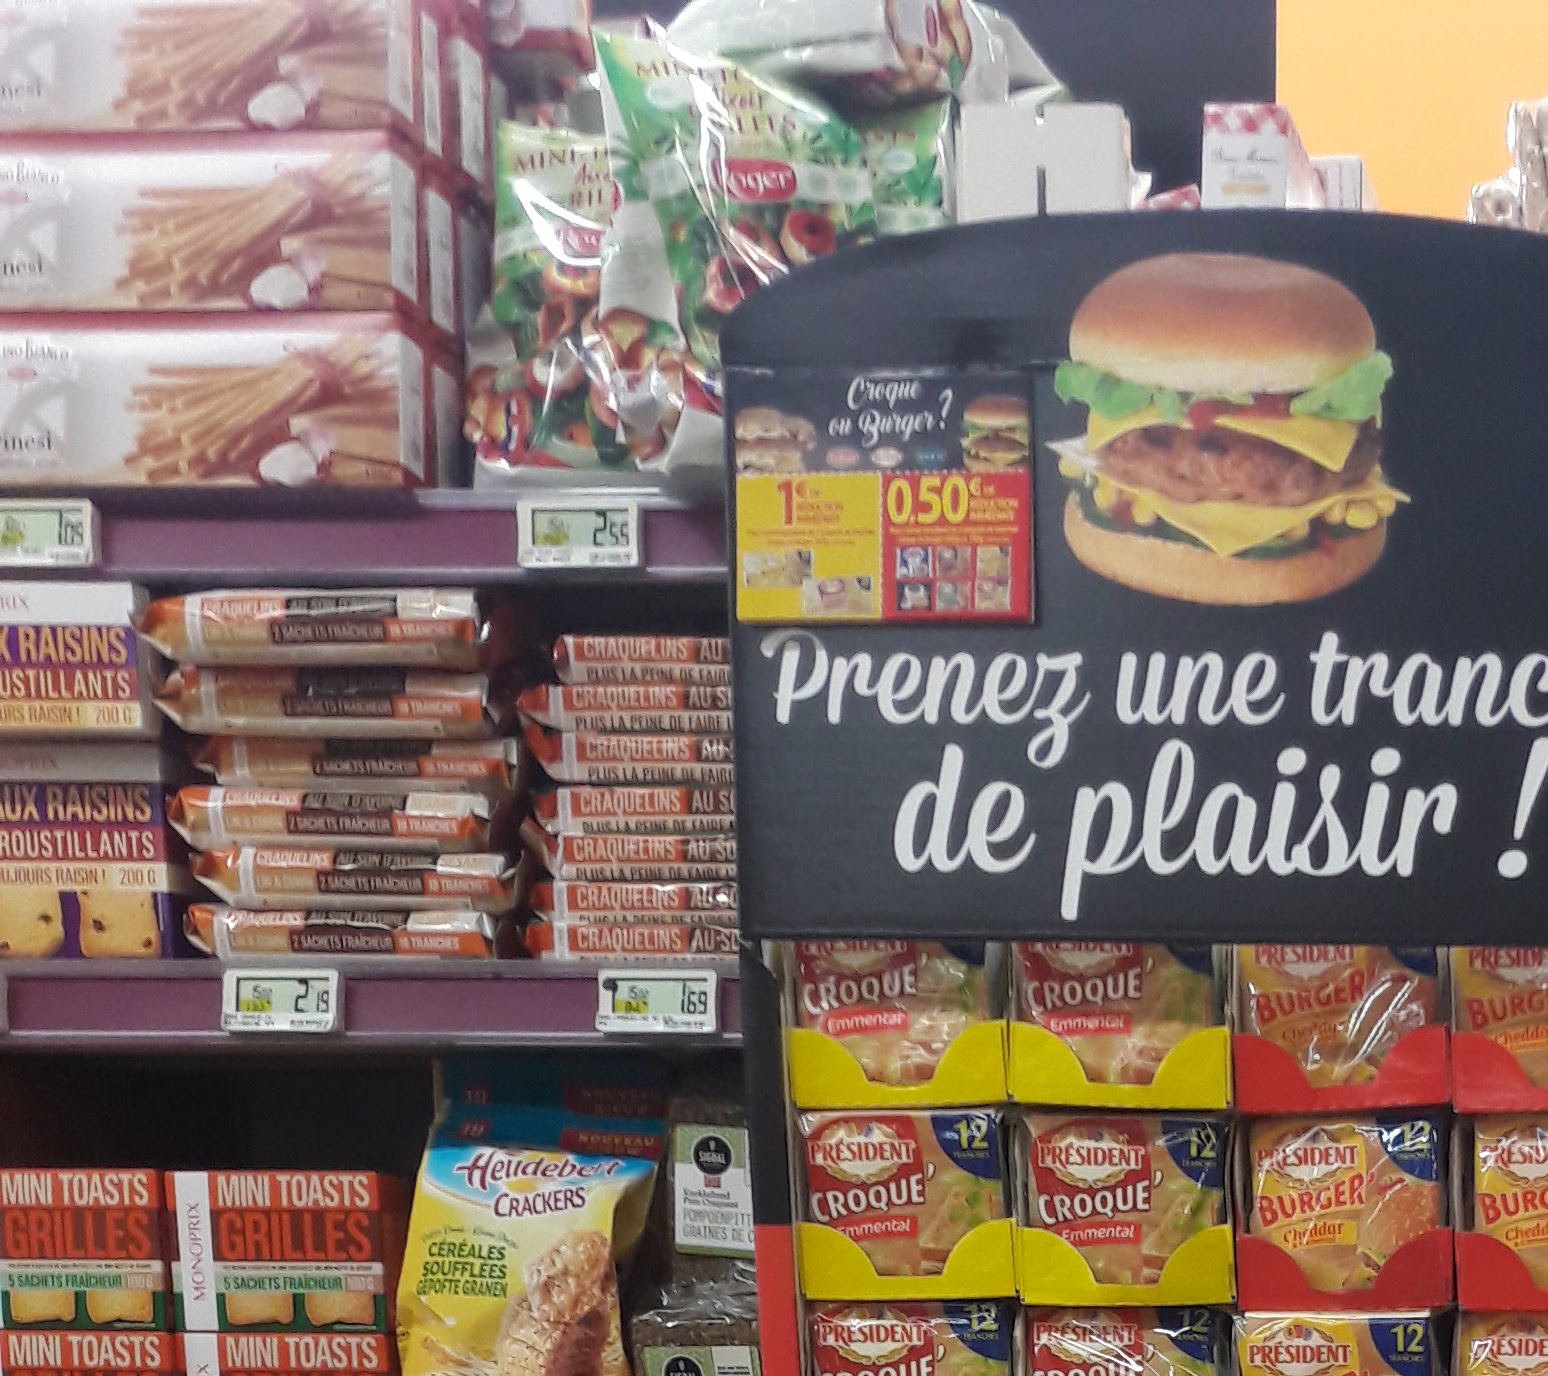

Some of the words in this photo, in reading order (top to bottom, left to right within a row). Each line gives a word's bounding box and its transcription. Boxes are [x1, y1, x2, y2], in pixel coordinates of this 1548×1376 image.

[847, 376, 922, 411] Croque
[858, 409, 936, 448] Burger
[18, 625, 128, 664] RAISINS
[572, 686, 677, 710] CRAQUELINS
[760, 626, 1090, 768] Prenez
[1115, 651, 1284, 728] une
[47, 786, 153, 823] RAISINS
[580, 789, 681, 813] CRAQUELINS
[692, 790, 715, 813] AU
[892, 743, 1038, 875] de
[1061, 736, 1459, 924] plaisir
[573, 837, 676, 862] CRAQUELINS
[1, 1174, 52, 1205] MINI
[60, 1174, 149, 1206] TOASTS
[217, 1175, 270, 1207] MINI
[277, 1175, 370, 1207] TOASTS
[494, 1187, 586, 1218] CRACKERS
[187, 1202, 208, 1302] MONOPRIX
[428, 1237, 507, 1260] CÉRÉALES
[18, 1273, 63, 1289] SACHETS
[226, 1336, 279, 1368] MINI
[285, 1336, 379, 1369] TOASTS
[1390, 1322, 1425, 1354] 12
